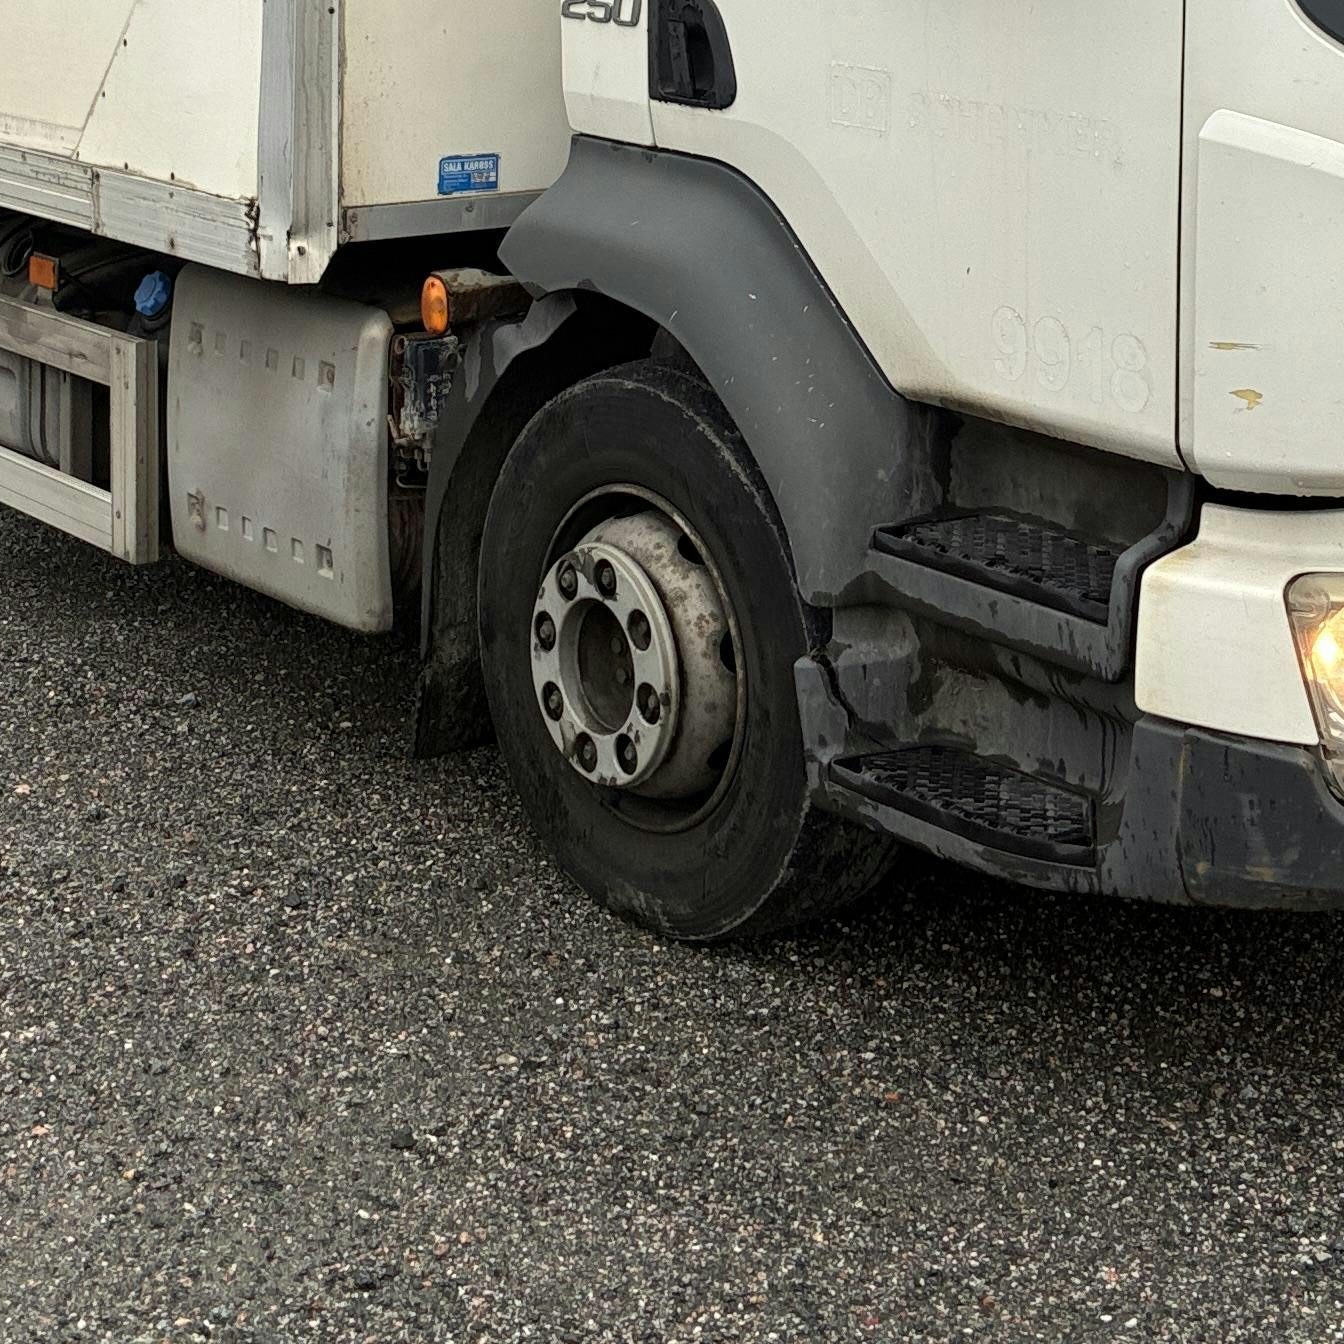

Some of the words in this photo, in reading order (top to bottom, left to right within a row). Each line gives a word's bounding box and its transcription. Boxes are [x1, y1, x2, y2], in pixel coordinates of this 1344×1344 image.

[443, 162, 463, 172] SALA
[464, 160, 494, 171] KAROSS
[991, 305, 1153, 413] 9918
